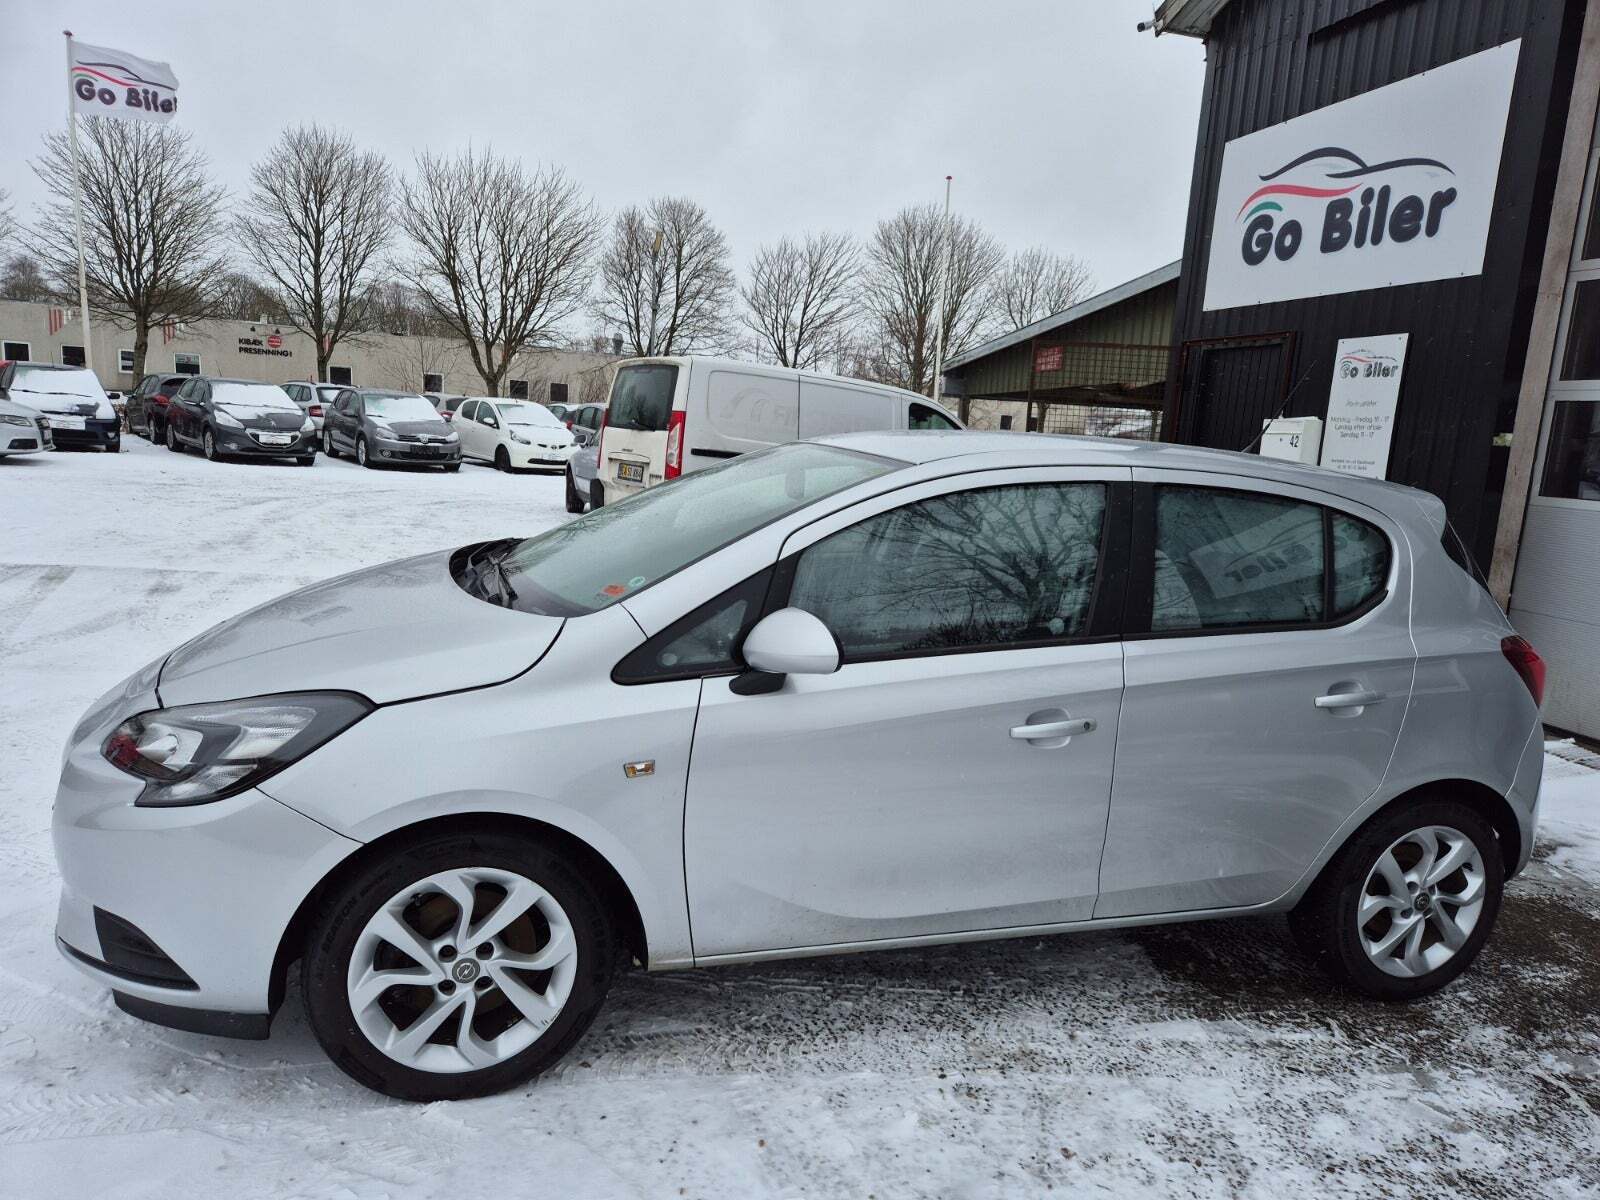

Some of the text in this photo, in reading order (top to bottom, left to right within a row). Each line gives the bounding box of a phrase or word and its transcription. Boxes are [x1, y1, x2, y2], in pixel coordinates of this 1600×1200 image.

[75, 79, 116, 105] Go
[1241, 184, 1457, 266] Go Biler
[238, 346, 289, 357] PRESENNING
[1340, 362, 1399, 379] Go Biler
[1289, 434, 1299, 447] 42
